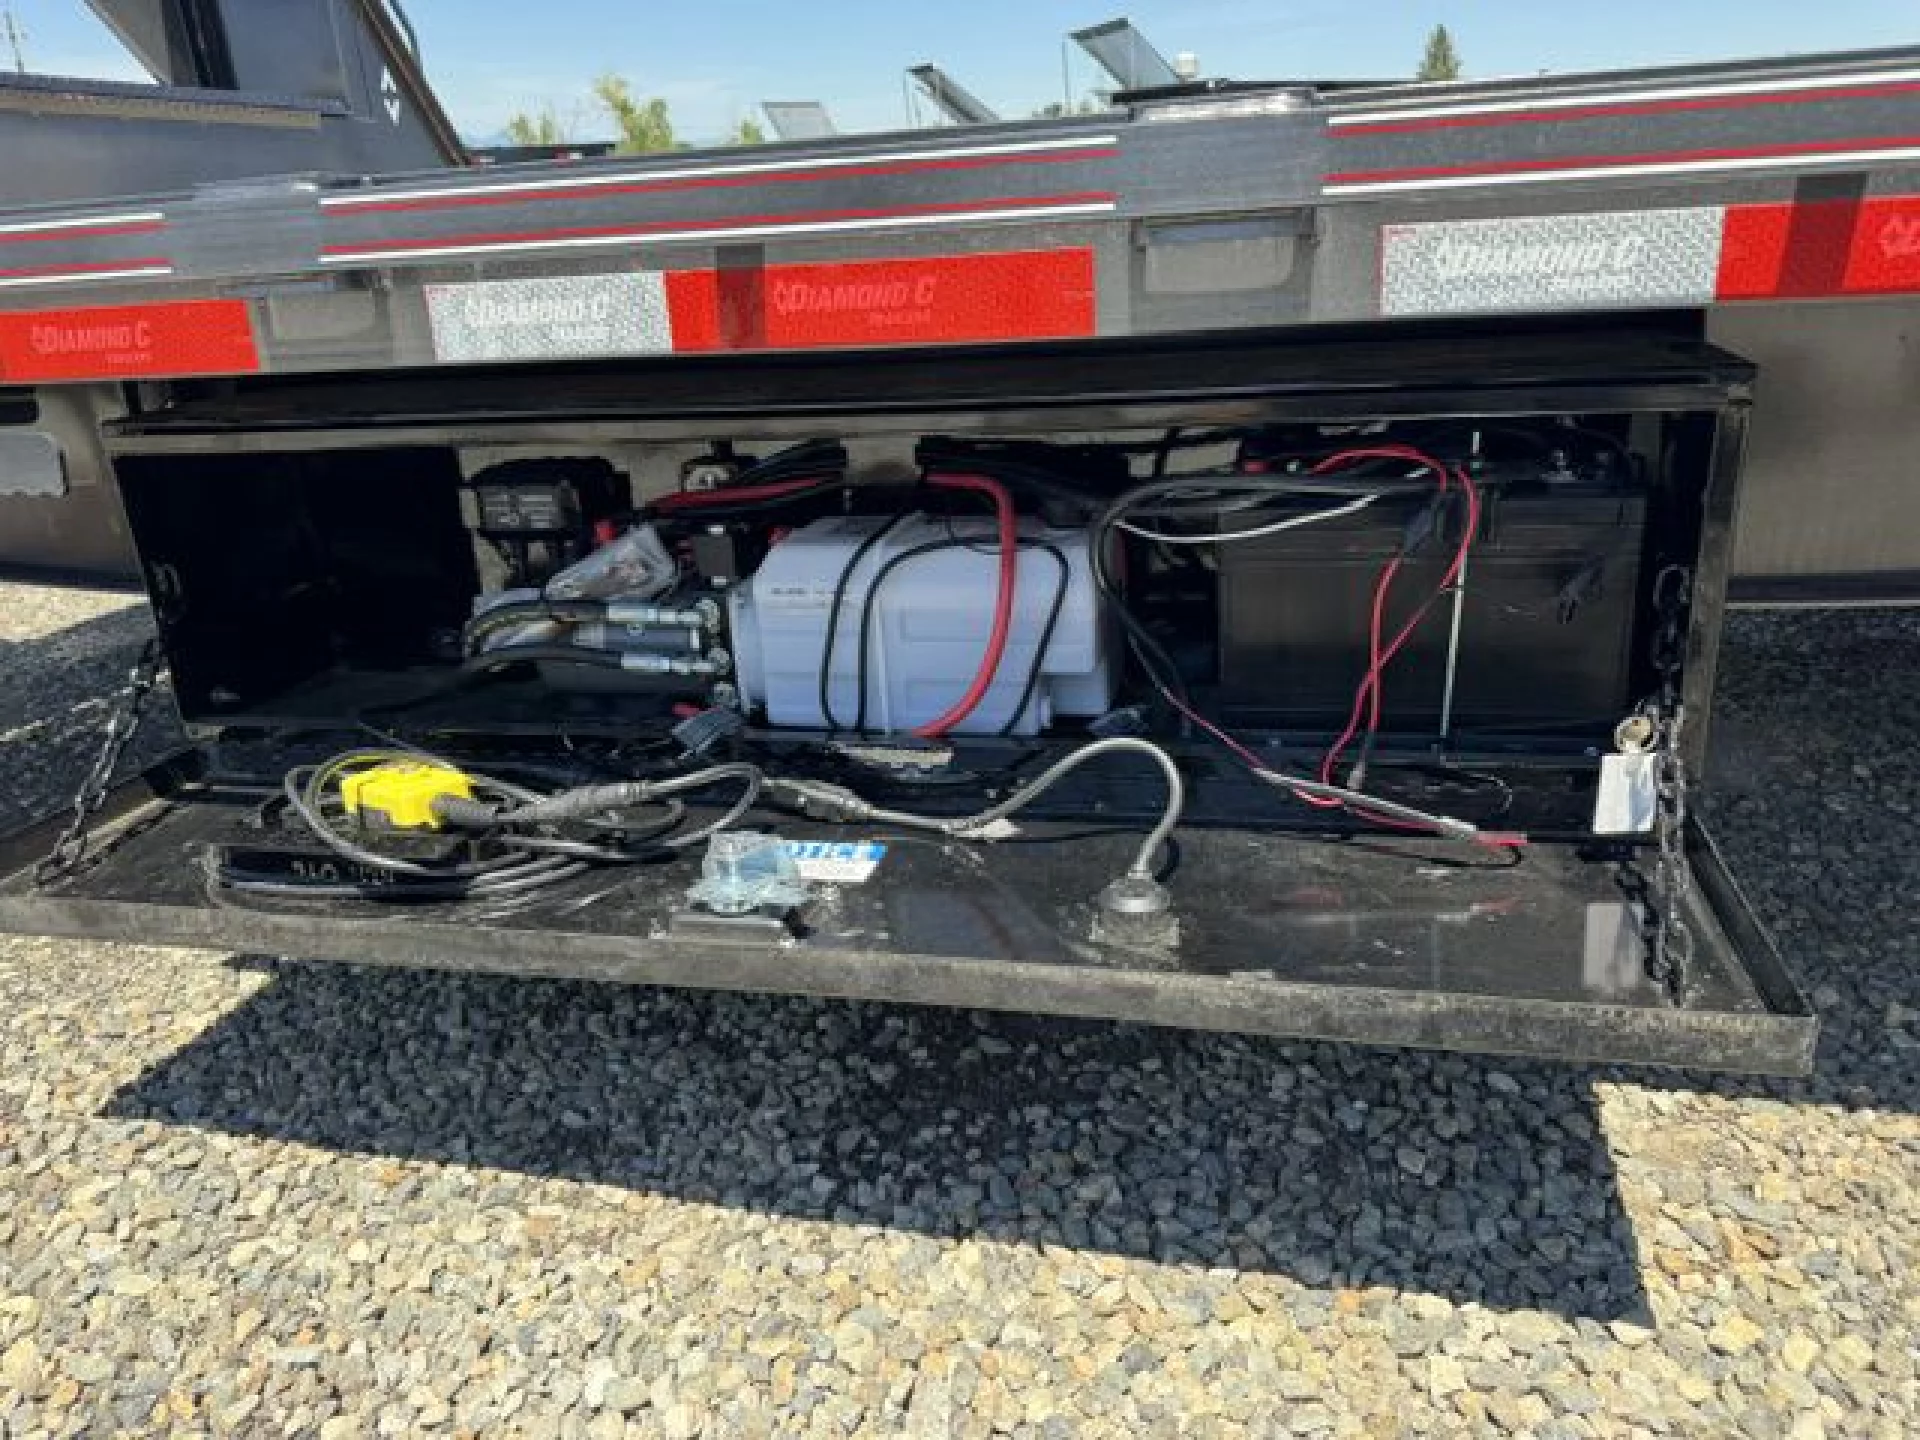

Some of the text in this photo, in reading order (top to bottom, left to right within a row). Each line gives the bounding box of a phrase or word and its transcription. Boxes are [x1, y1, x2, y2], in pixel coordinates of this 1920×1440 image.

[1453, 243, 1606, 276] DIAMOND
[480, 293, 609, 325] DIAMOND C
[791, 277, 936, 312] DIAMOND C
[44, 320, 151, 352] DIAMOND C
